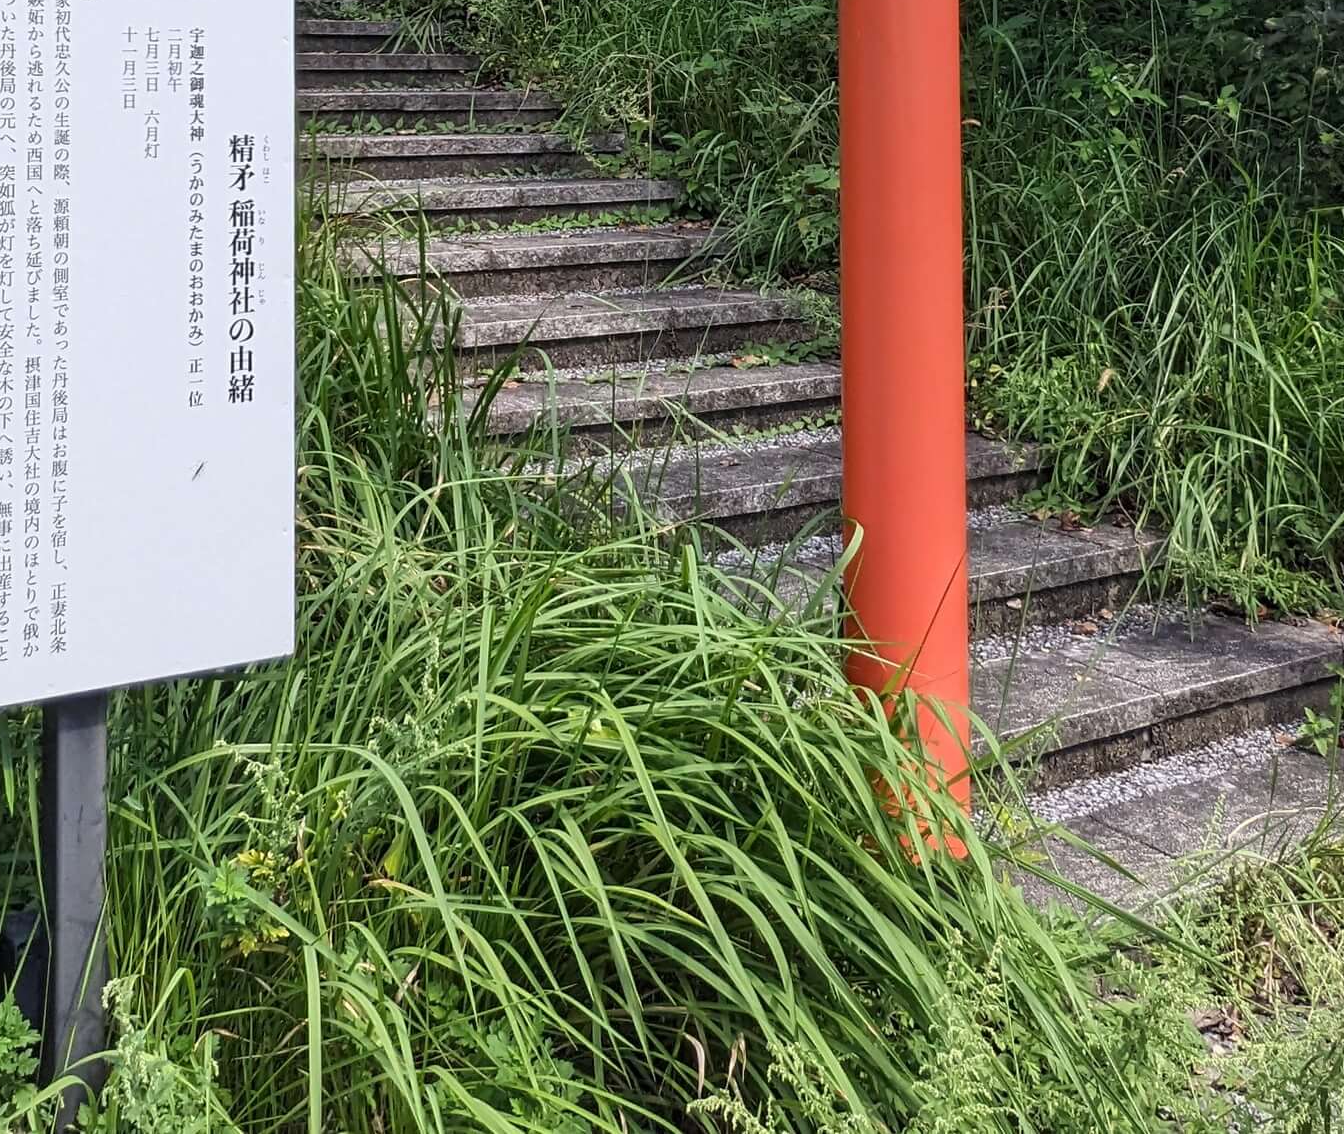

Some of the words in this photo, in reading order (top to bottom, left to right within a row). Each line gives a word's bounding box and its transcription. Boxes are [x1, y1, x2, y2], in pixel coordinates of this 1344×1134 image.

[121, 25, 139, 110] 十一月三日
[144, 26, 161, 93] 七月三日
[167, 28, 183, 93] 二月初午
[144, 109, 161, 159] 六月灯
[188, 357, 204, 408] 正一位
